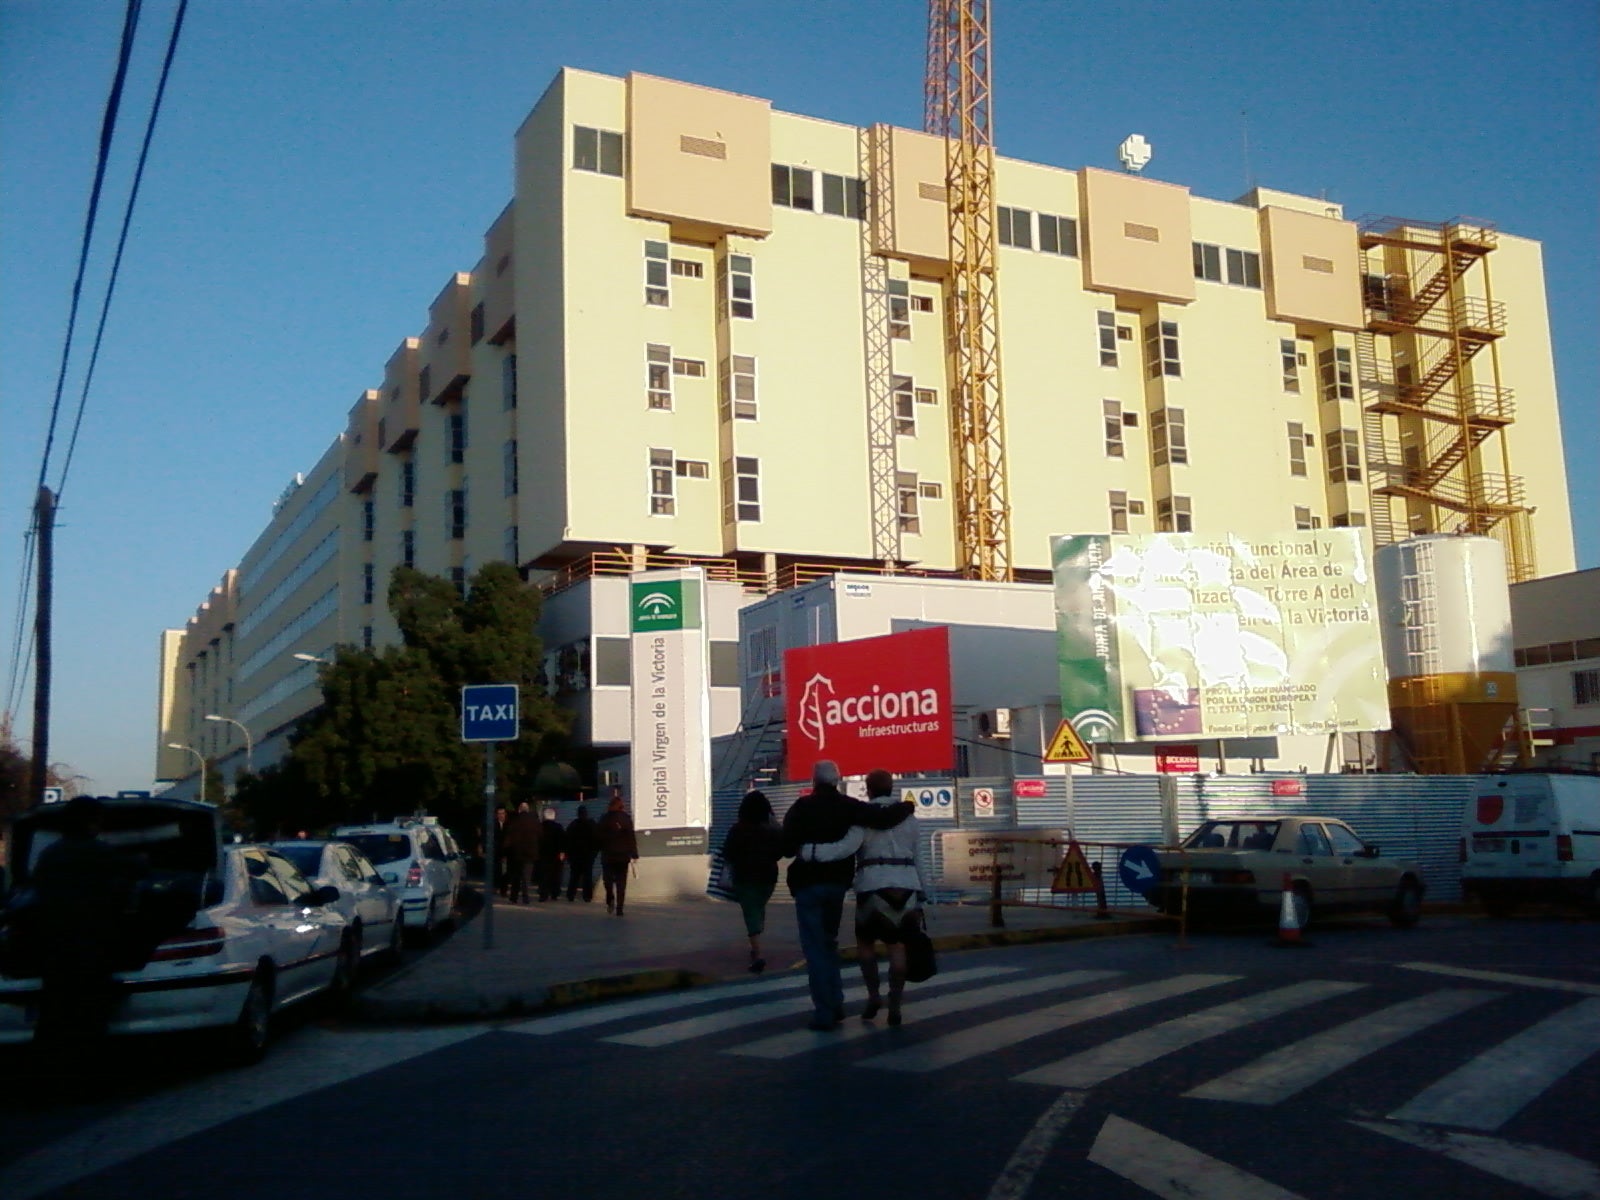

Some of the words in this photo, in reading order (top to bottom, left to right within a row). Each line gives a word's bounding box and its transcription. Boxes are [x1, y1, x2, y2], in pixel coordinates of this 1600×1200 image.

[1243, 540, 1318, 556] uncional
[1323, 542, 1332, 557] y
[1250, 564, 1275, 580] del
[1281, 560, 1318, 579] Área
[1323, 561, 1343, 577] de
[1264, 586, 1308, 602] Torre
[1313, 586, 1324, 600] A
[1330, 584, 1355, 600] del
[1288, 608, 1303, 625] la
[651, 637, 665, 684] Victoria
[651, 686, 666, 698] la
[1206, 696, 1225, 705] POR
[466, 704, 514, 721] TAXI
[651, 702, 666, 718] de
[825, 684, 938, 726] acciona
[858, 720, 940, 738] Infraestructuras
[652, 721, 670, 763] Virgen
[651, 766, 670, 819] Hospital
